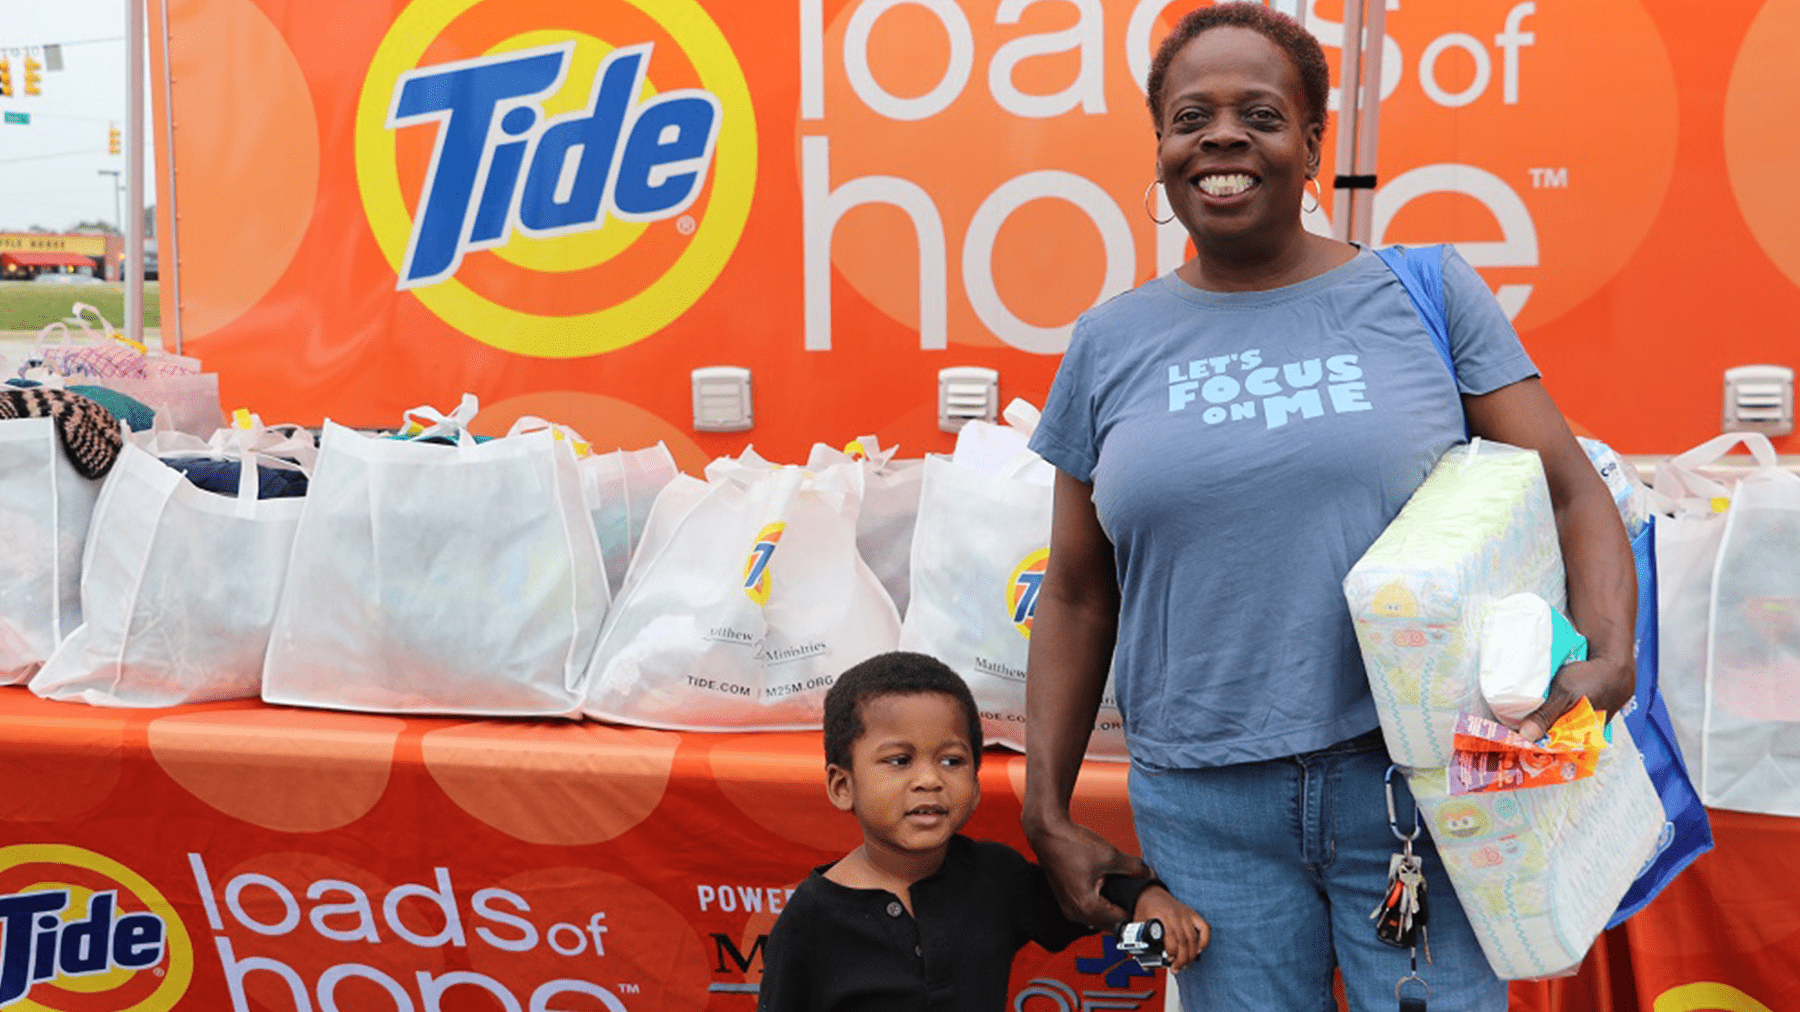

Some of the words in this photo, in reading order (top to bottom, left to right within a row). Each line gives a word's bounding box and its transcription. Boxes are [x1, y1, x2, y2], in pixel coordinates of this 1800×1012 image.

[1419, 2, 1537, 107] of
[384, 40, 723, 291] Tide
[803, 136, 1539, 354] hoe
[1168, 349, 1262, 383] LET'S
[1168, 354, 1363, 411] FOCUS
[1202, 401, 1256, 424] ON
[1262, 382, 1373, 429] ME
[766, 642, 827, 662] Ministries
[975, 656, 1027, 679] Matthew
[687, 675, 751, 696] TIDE.COM
[766, 675, 834, 698] M25M.ORG
[187, 853, 539, 952] loads
[546, 912, 608, 956] of
[0, 889, 166, 1010] Tide
